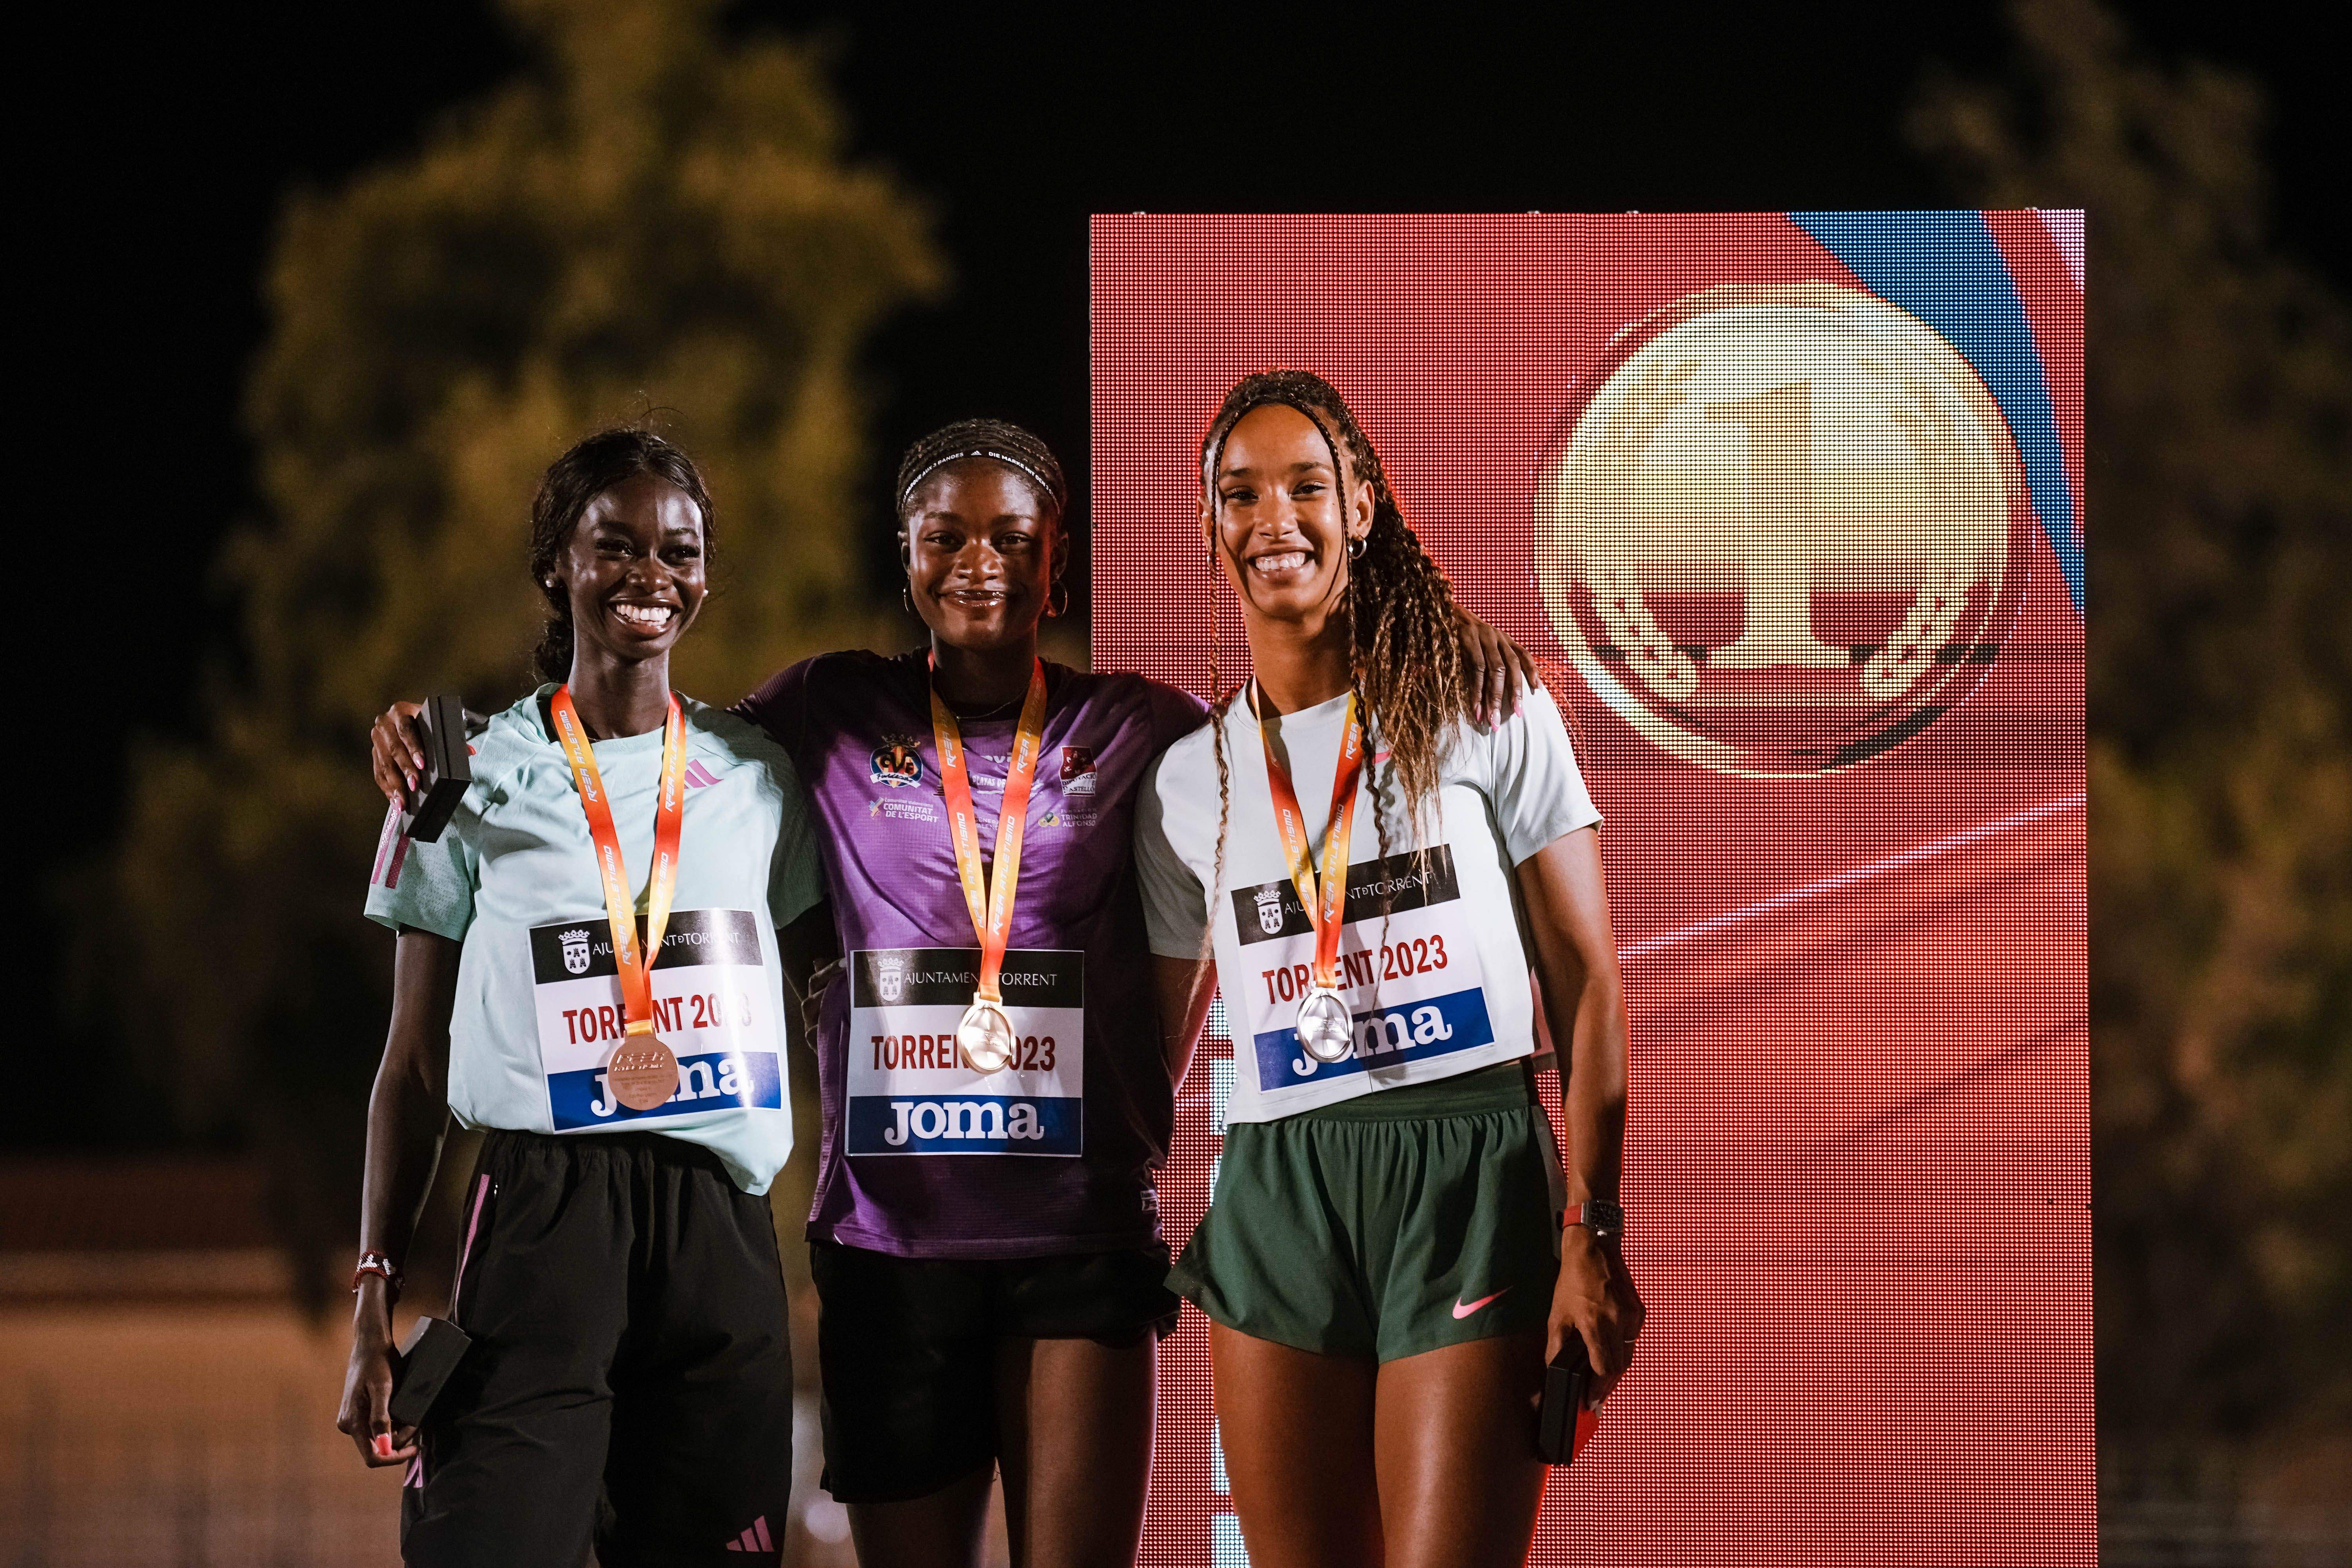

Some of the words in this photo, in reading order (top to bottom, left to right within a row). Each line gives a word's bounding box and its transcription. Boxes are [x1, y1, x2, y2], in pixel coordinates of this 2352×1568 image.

[559, 710, 586, 764] ATLETISMO
[670, 711, 679, 775] ATLETISMO
[1016, 739, 1030, 774] RFEA
[579, 768, 598, 802] RFEA
[665, 776, 676, 813] RFEA
[883, 803, 933, 815] COMUNITAT
[898, 811, 939, 823] L'ESPORT
[956, 812, 976, 885] ATLETISMO
[1329, 804, 1345, 877] ATLETISMO
[603, 845, 625, 920] ATLETISMO
[993, 893, 1005, 936] RFEA
[1000, 815, 1015, 891] ATLETISMO
[1324, 880, 1335, 924] RFEA
[616, 924, 632, 965] RFEA
[904, 972, 979, 986] AJUNTAMEN
[1262, 949, 1374, 1005] TORENT
[1380, 935, 1448, 981] 2023
